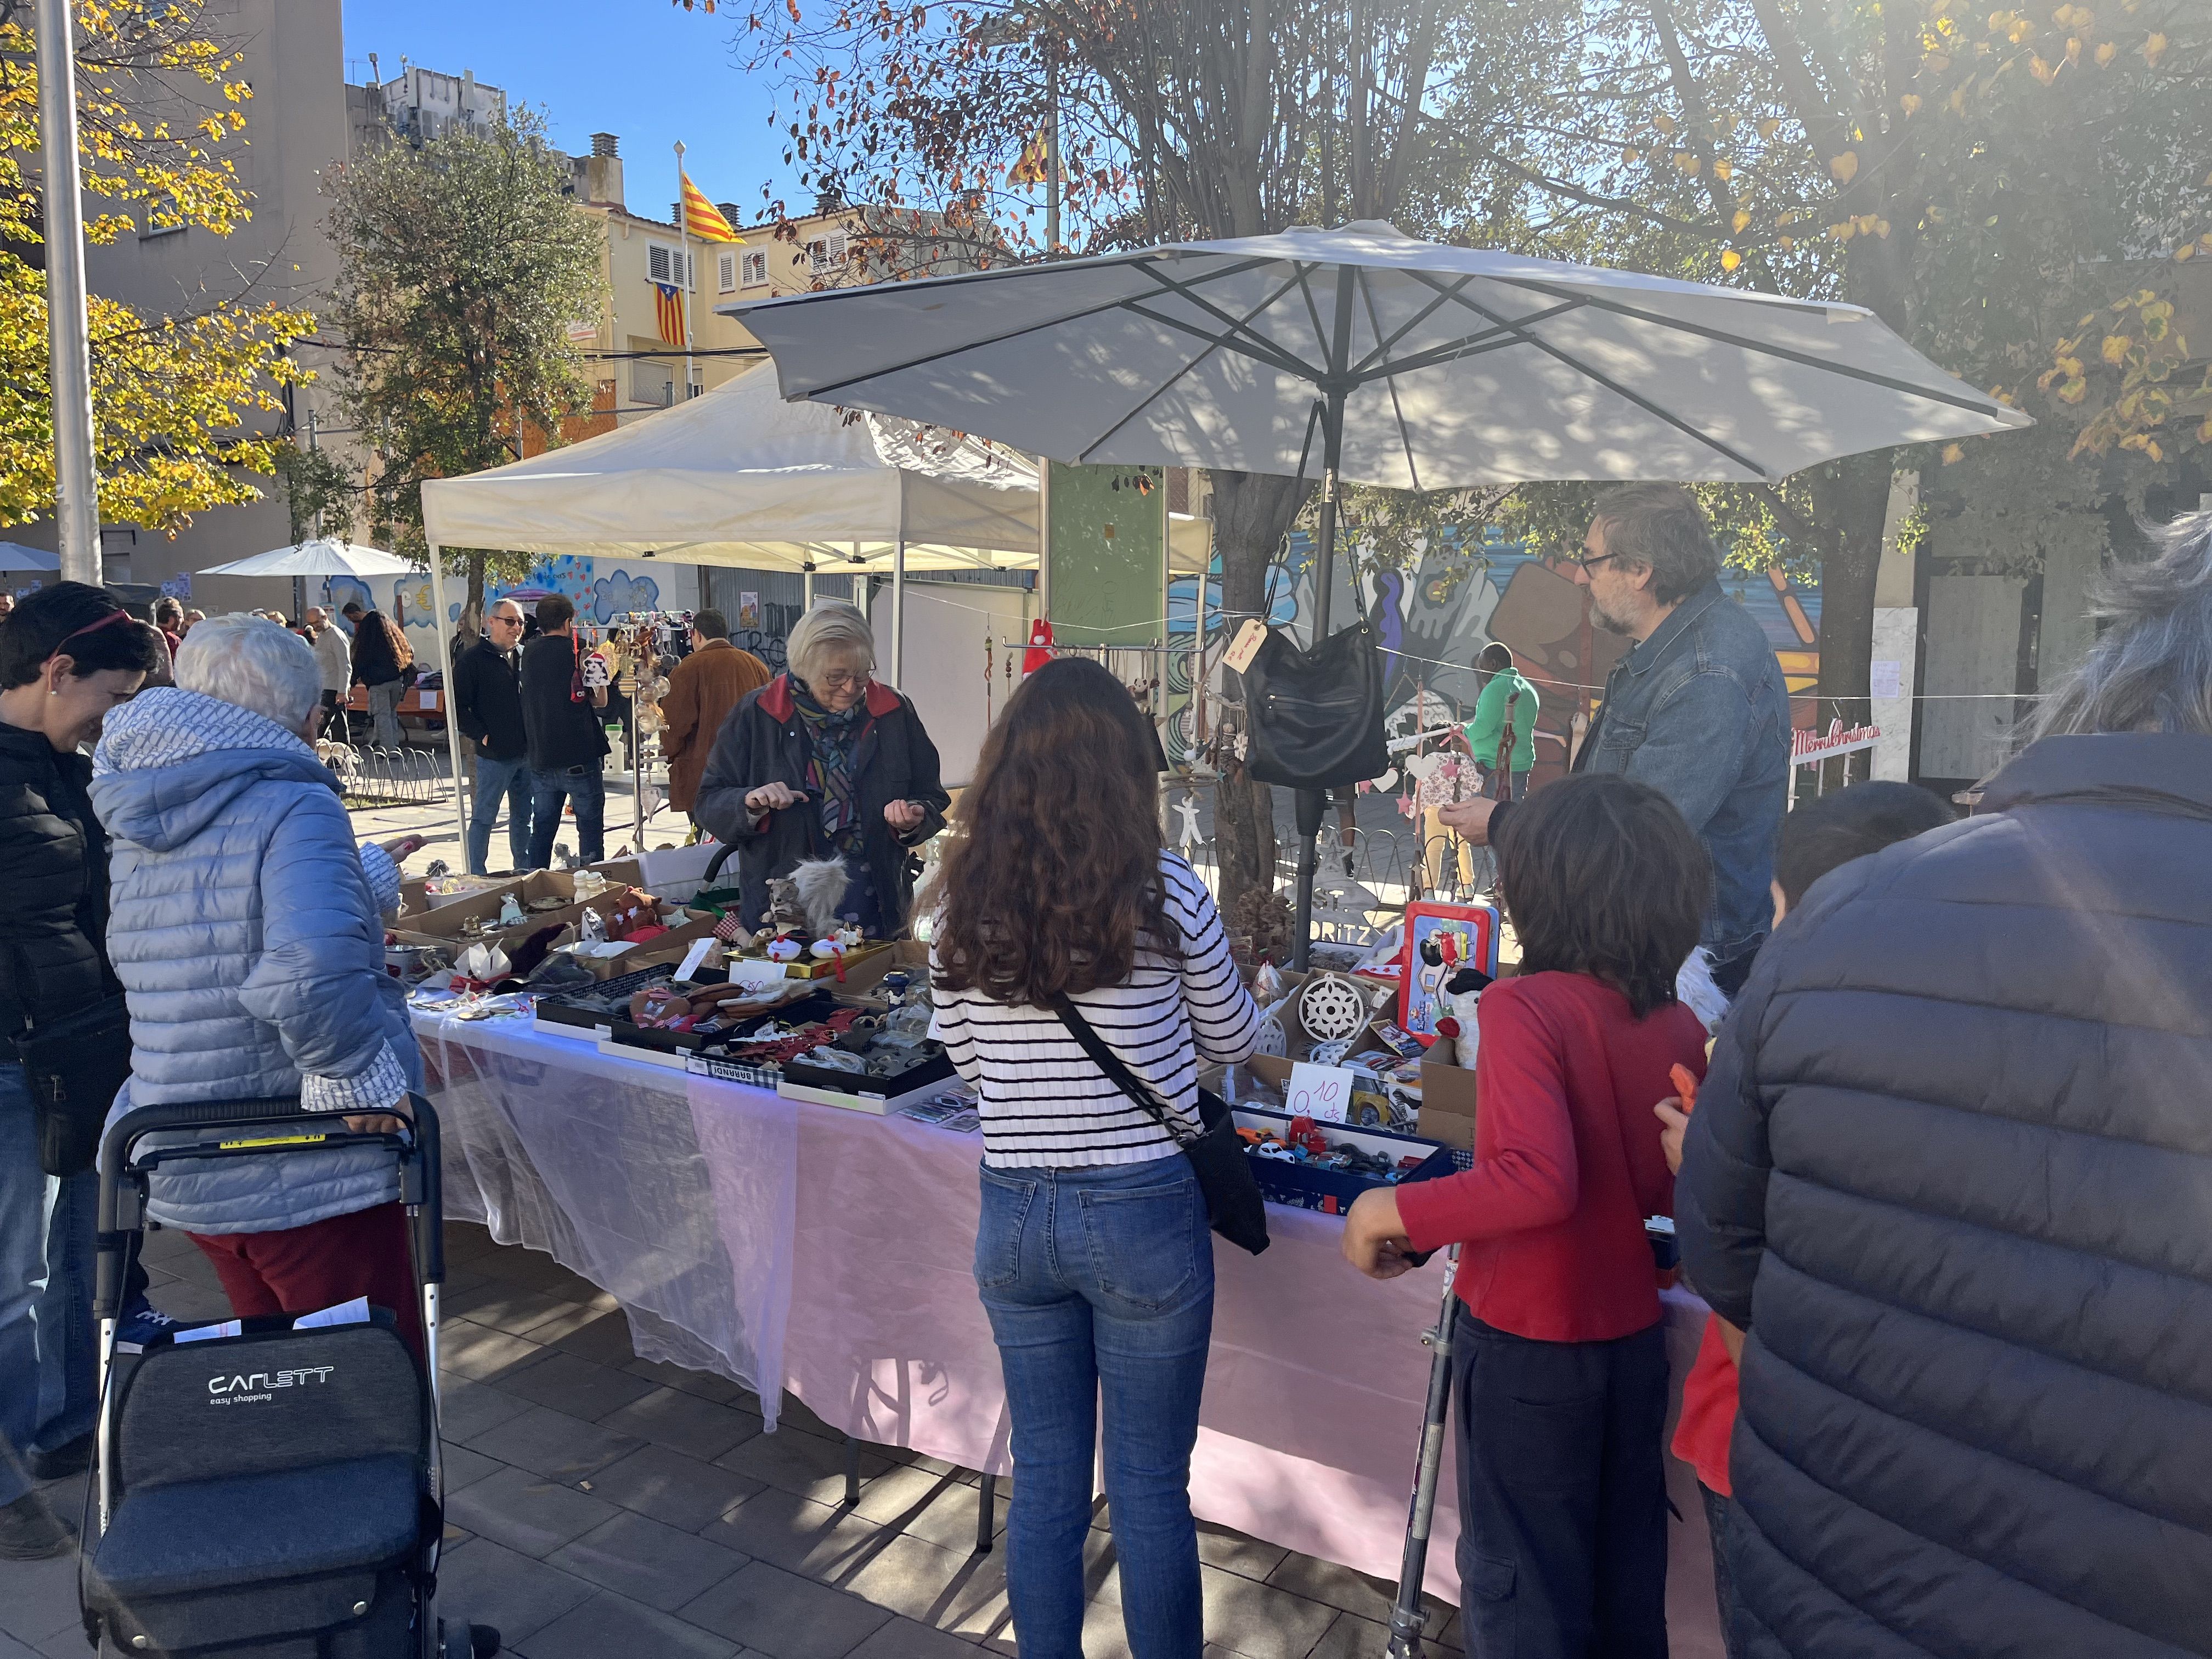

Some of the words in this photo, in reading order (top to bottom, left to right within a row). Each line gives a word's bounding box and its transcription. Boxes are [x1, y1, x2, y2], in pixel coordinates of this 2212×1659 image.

[208, 1366, 334, 1394] CARLETT
[210, 1396, 231, 1405] easy
[234, 1392, 272, 1403] shopping
